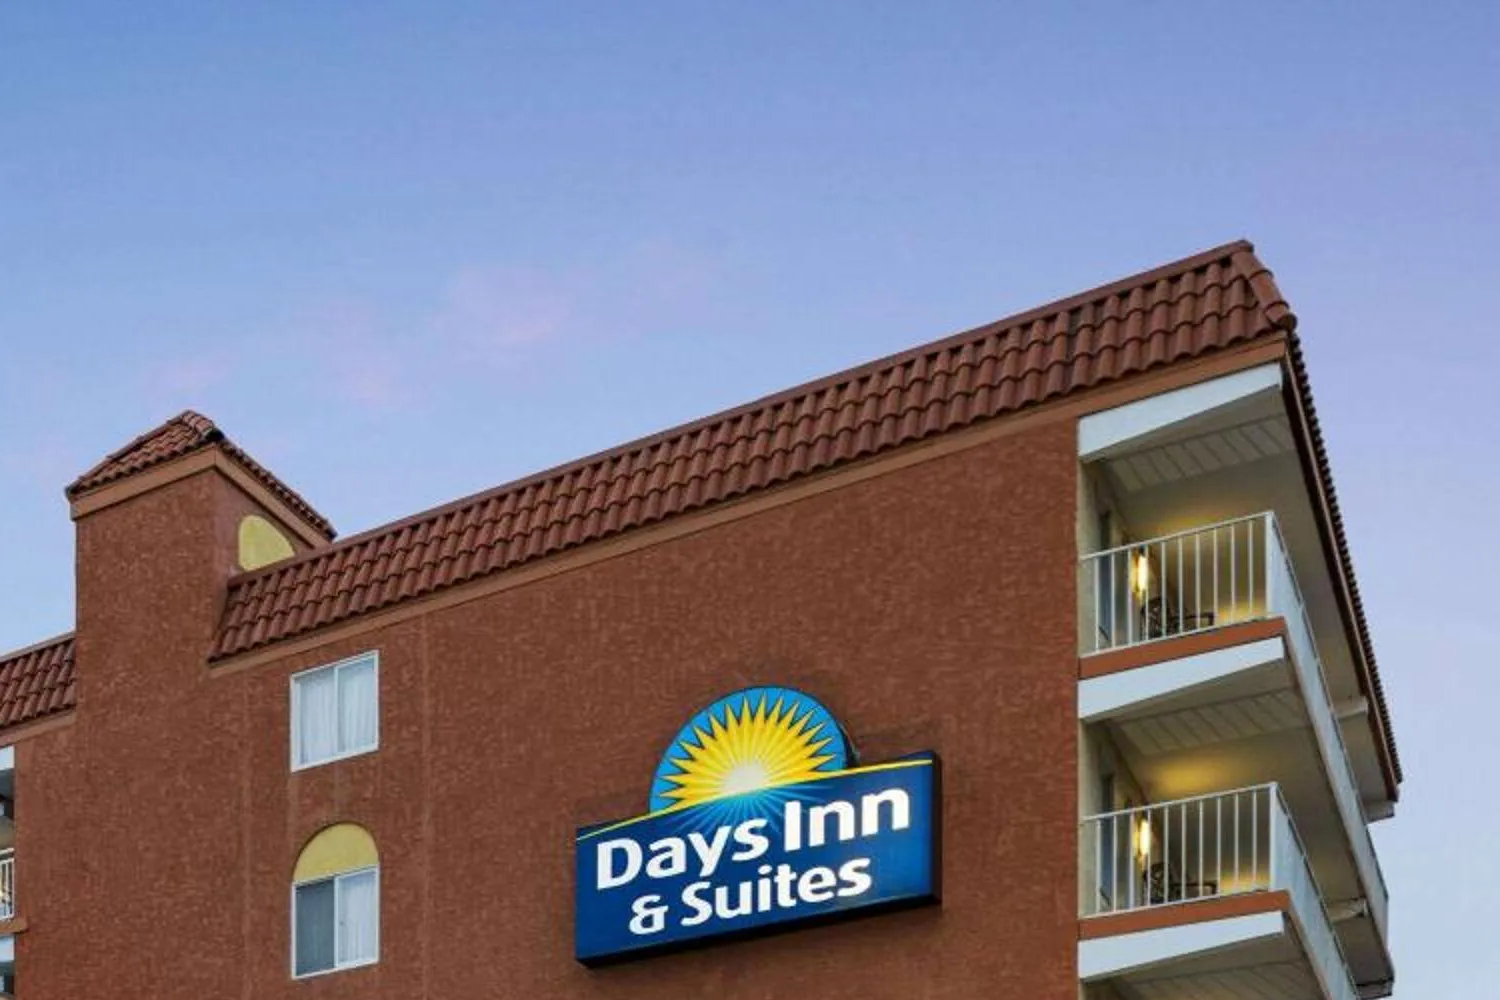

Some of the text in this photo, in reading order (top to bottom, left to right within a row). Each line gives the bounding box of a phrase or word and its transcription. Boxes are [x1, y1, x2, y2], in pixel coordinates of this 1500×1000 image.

[596, 787, 910, 891] Days Inn
[628, 857, 872, 936] & Suites
